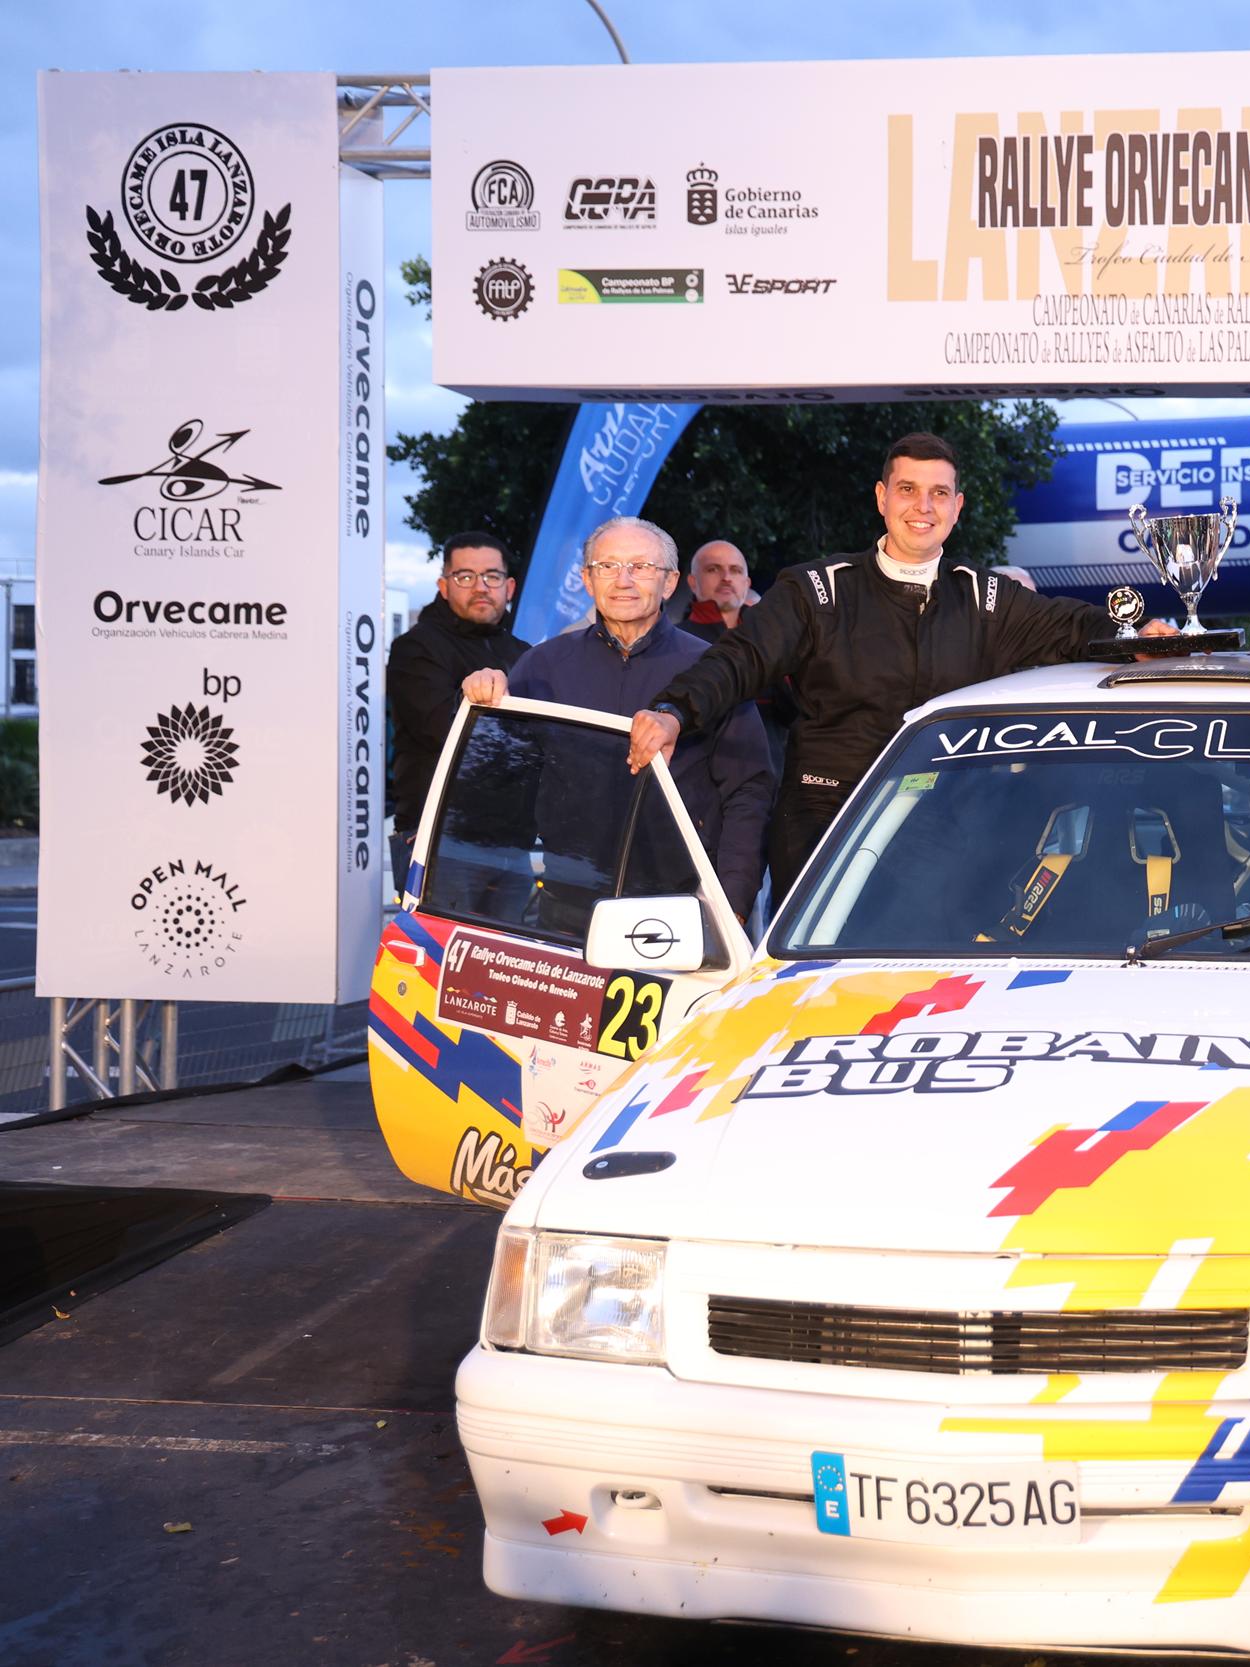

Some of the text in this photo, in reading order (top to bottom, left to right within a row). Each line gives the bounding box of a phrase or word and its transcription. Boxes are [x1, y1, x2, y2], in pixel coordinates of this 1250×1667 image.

[128, 129, 248, 257] ORVECAME ISLA LANZAROTE
[169, 169, 208, 221] 47
[487, 178, 519, 206] FCA
[725, 187, 803, 203] Gobierno
[977, 134, 1094, 229] RALLYE
[468, 214, 538, 230] AUTOMOVILISMO
[725, 204, 820, 219] de Canarias
[724, 223, 789, 239] islas iguales
[1063, 240, 1132, 281] Trofeo
[1138, 243, 1217, 265] Ciudad
[1212, 243, 1235, 263] de
[601, 277, 675, 289] Campeonato BP
[1032, 293, 1128, 326] CAMPEONATO
[1130, 302, 1140, 326] de
[1142, 292, 1212, 325] CANARIAS
[1214, 301, 1224, 325] de
[944, 332, 1039, 364] CAMPEONATO
[1041, 340, 1051, 364] de
[1053, 331, 1110, 364] RALLYES
[1112, 339, 1122, 363] de
[1126, 330, 1184, 364] ASFALTO
[1186, 338, 1196, 363] de
[1199, 329, 1225, 363] LAS
[355, 279, 377, 539] Orvecame
[1116, 467, 1216, 488] SERVICIO
[133, 507, 244, 542] CICAR
[134, 545, 245, 560] Canary Islands Car
[806, 569, 829, 606] sparco
[985, 575, 998, 613] sparco
[93, 590, 288, 626] Orvecame
[91, 627, 157, 641] Organización
[209, 628, 249, 640] Cabrera
[251, 629, 288, 641] Medina
[202, 667, 242, 703] bp
[355, 614, 376, 872] Orvecame
[938, 720, 1118, 756] VICAL
[801, 773, 840, 786] sparco
[130, 858, 248, 913] OPEN MALL
[134, 929, 244, 979] LANZAROTE
[447, 938, 472, 974] 47
[470, 945, 606, 990] Rallye Orvecame Isla de Lanzarote
[488, 968, 578, 1000] Trofeo Ciudad de Arrecife
[444, 994, 498, 1017] LANZAROTE
[597, 975, 663, 1062] 23
[732, 1056, 1020, 1104] BUS
[824, 1500, 840, 1519] E
[850, 1472, 1077, 1528] TF 6325 AG
